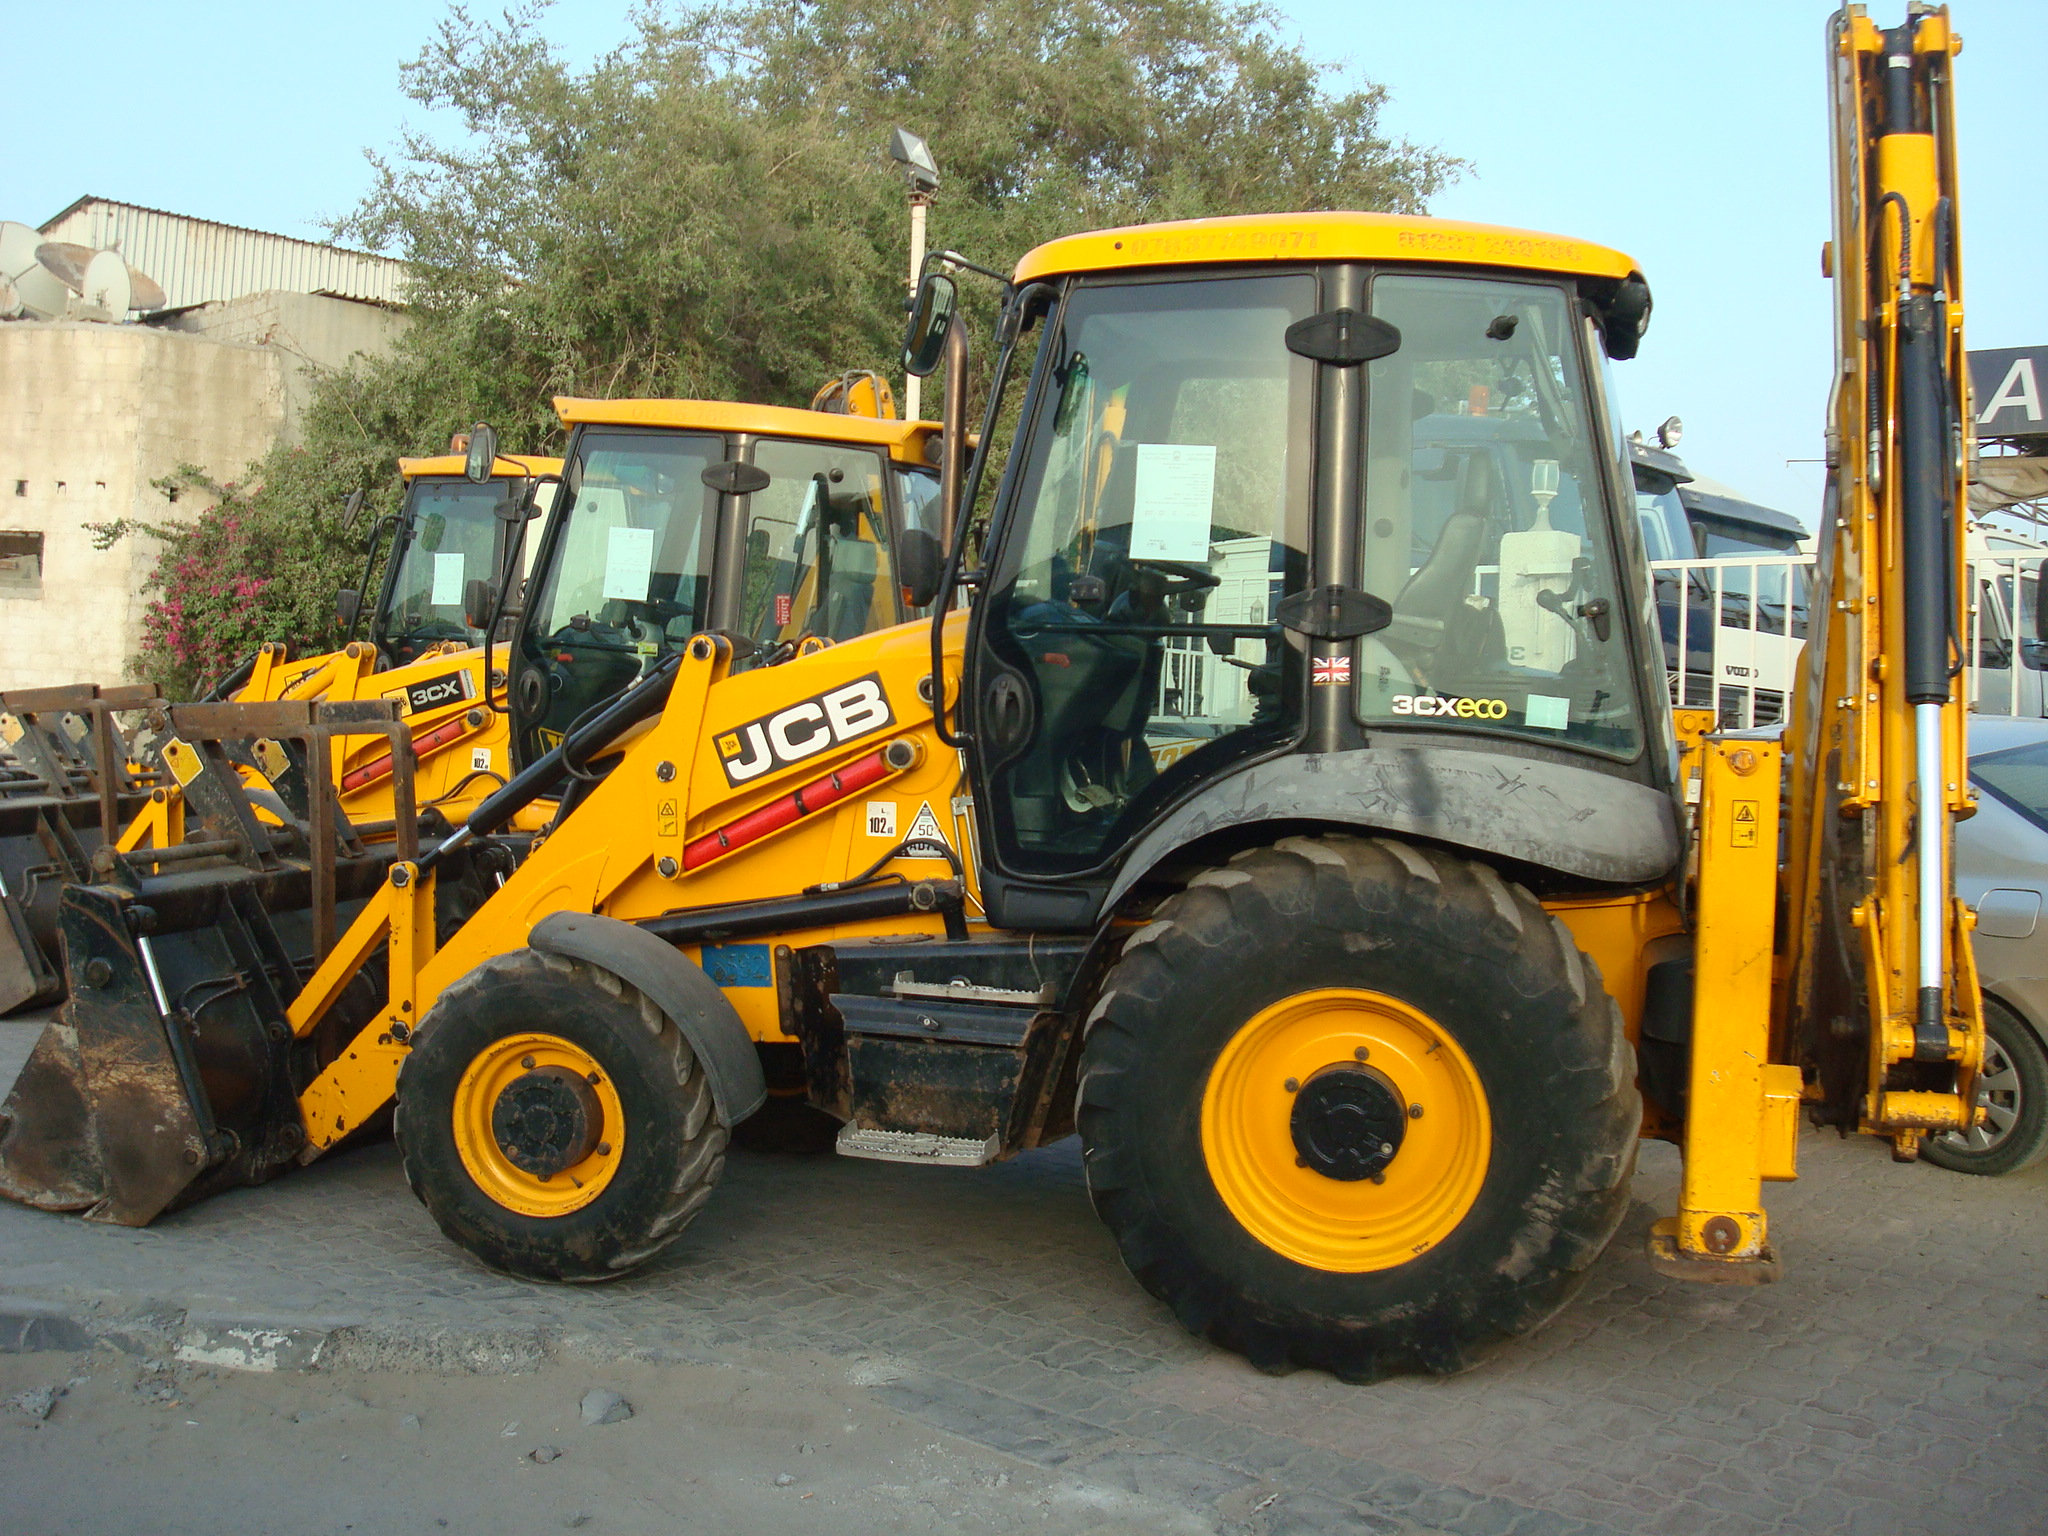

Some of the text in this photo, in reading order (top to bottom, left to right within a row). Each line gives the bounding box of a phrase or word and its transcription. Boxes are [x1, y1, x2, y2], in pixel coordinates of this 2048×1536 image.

[1976, 358, 2043, 424] A
[412, 680, 460, 706] 3CX
[727, 680, 890, 781] JCB
[869, 816, 887, 834] 102
